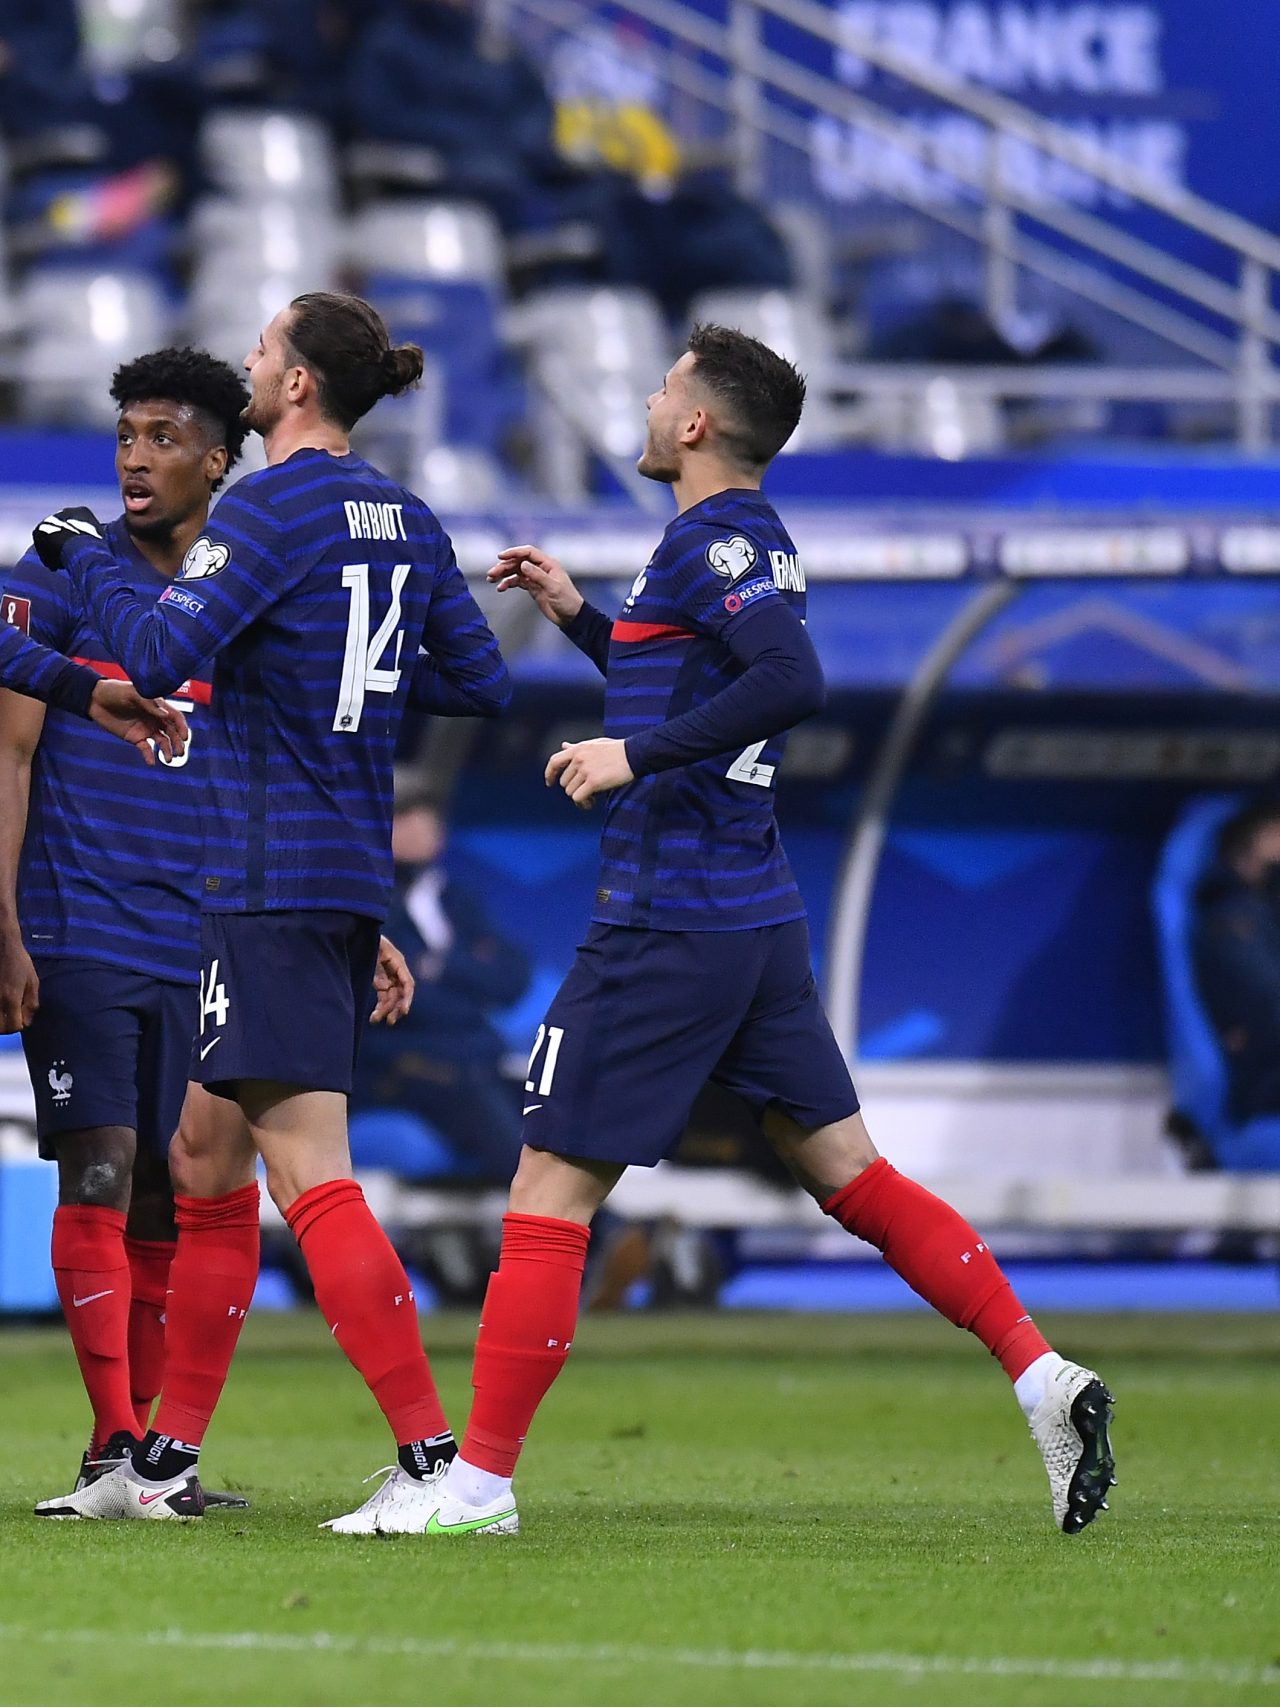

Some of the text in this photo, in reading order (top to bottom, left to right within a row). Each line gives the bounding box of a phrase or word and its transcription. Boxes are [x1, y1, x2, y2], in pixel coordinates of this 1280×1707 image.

[832, 3, 1160, 92] FRANCE
[343, 500, 407, 541] RABIOT
[332, 563, 411, 733] 14
